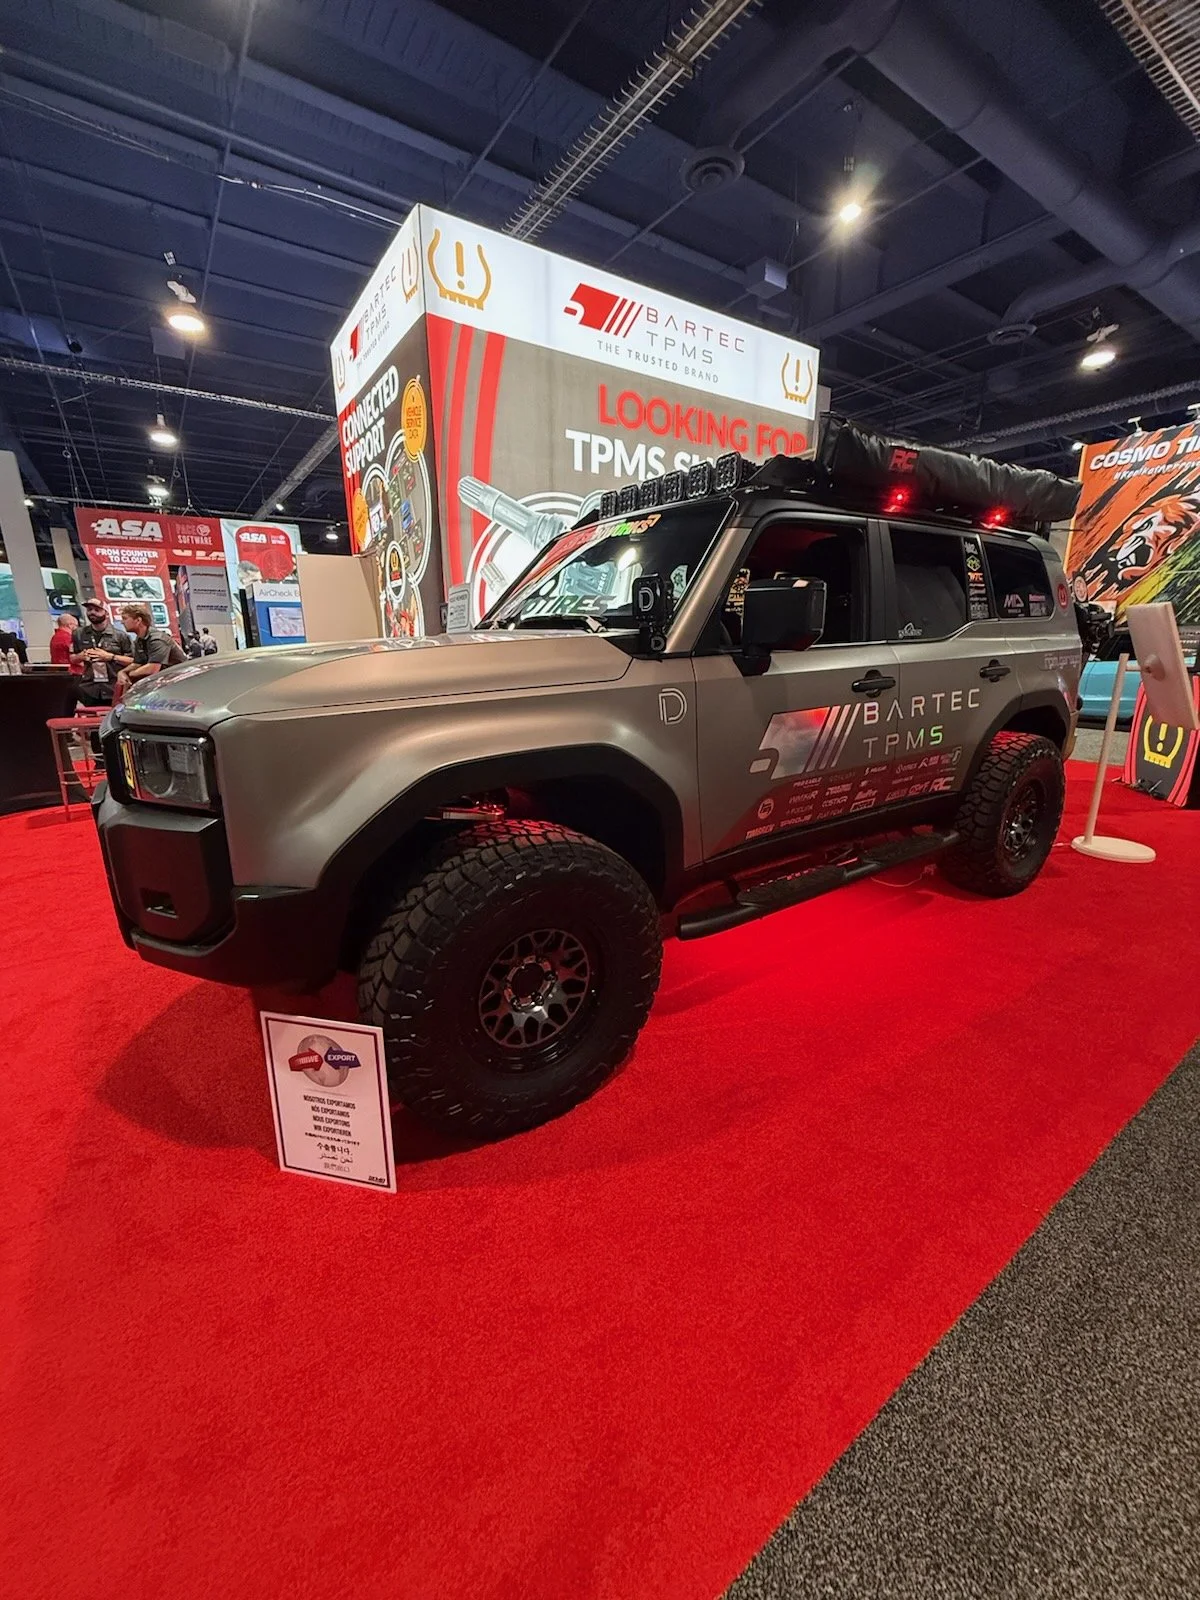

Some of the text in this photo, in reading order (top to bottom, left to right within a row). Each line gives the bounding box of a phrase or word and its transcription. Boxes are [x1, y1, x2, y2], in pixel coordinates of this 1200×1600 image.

[364, 266, 396, 323] BARTEC
[646, 306, 745, 353] BARTEC
[597, 339, 719, 384] THE TRUSTED BRAND
[646, 330, 714, 365] TPMS
[342, 365, 399, 447] CONNECTED
[598, 383, 749, 454] LOOKING
[345, 417, 385, 478] SUPPORT
[565, 429, 666, 481] TPMS
[1089, 441, 1171, 471] COSMO
[91, 517, 163, 538] ASA
[177, 535, 213, 545] SOFTWARE
[95, 548, 159, 558] FROM COUNTER
[121, 556, 149, 564] CLOUD
[259, 588, 294, 597] AirCheck
[863, 688, 980, 725] BARTEC
[863, 725, 943, 759] TPMS
[327, 1054, 356, 1062] EXPORT
[321, 1107, 350, 1118] EXPORTAMOS
[327, 1098, 356, 1110] EXPORTAMOS
